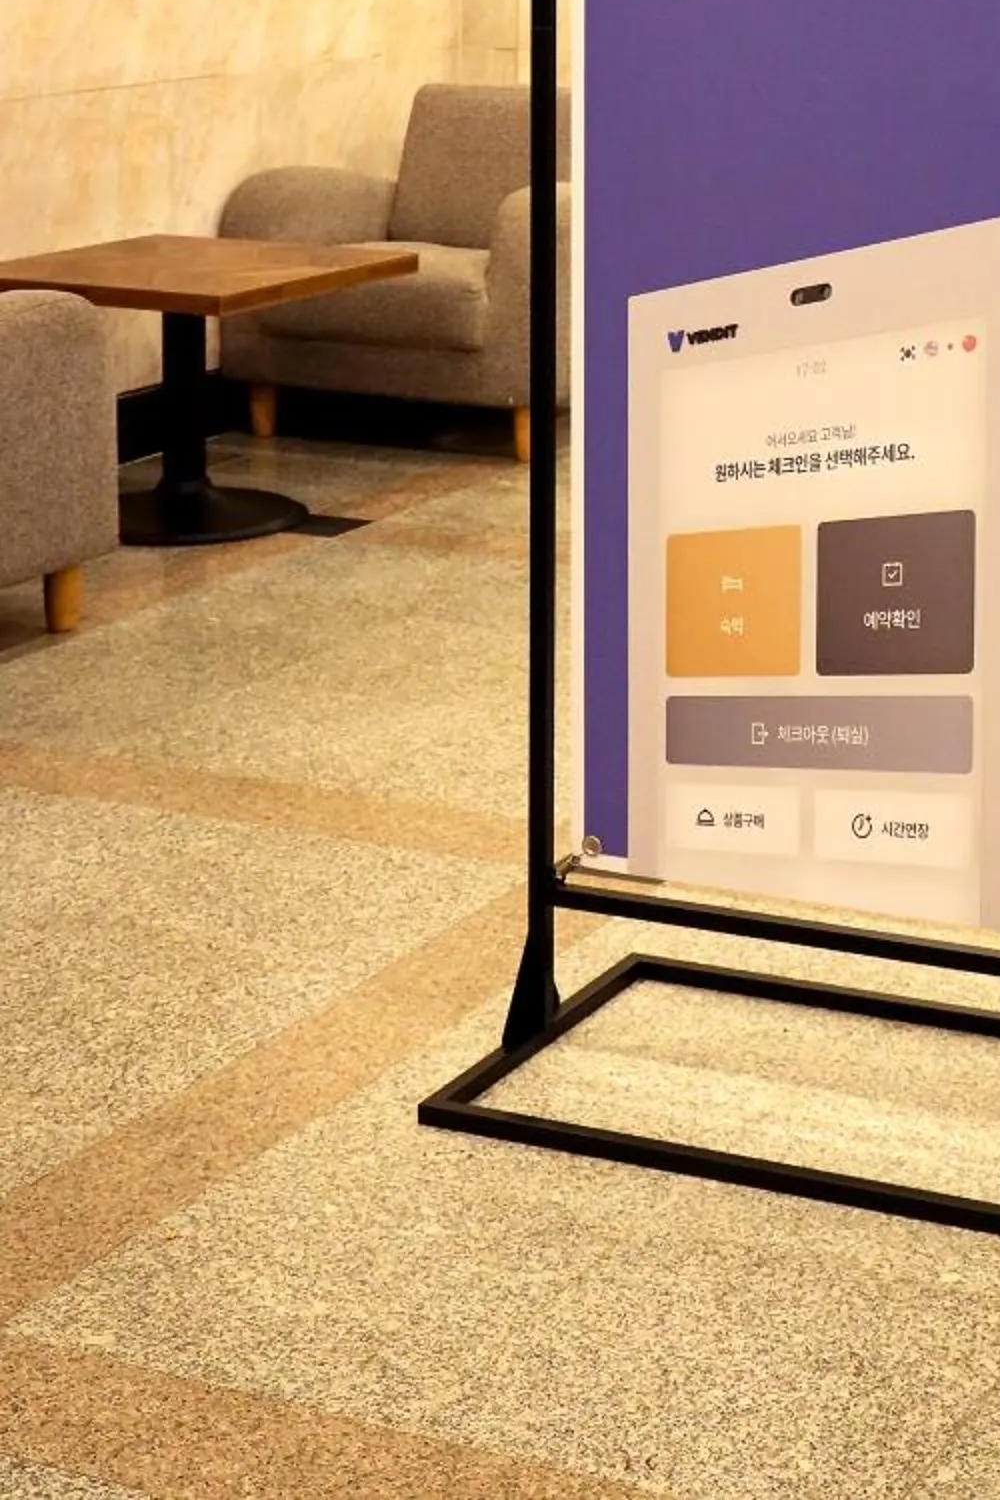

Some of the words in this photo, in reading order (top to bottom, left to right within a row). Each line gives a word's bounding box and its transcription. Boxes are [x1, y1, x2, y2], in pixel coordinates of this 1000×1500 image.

[686, 324, 738, 345] VENDIT
[715, 459, 766, 483] 원하시는
[767, 452, 821, 475] 체크인을
[825, 443, 916, 471] 선택해주세요.
[863, 608, 921, 631] 예약확인
[777, 724, 830, 744] 체크아웃
[723, 812, 765, 830] 상품구매
[881, 822, 929, 841] 시간연장
